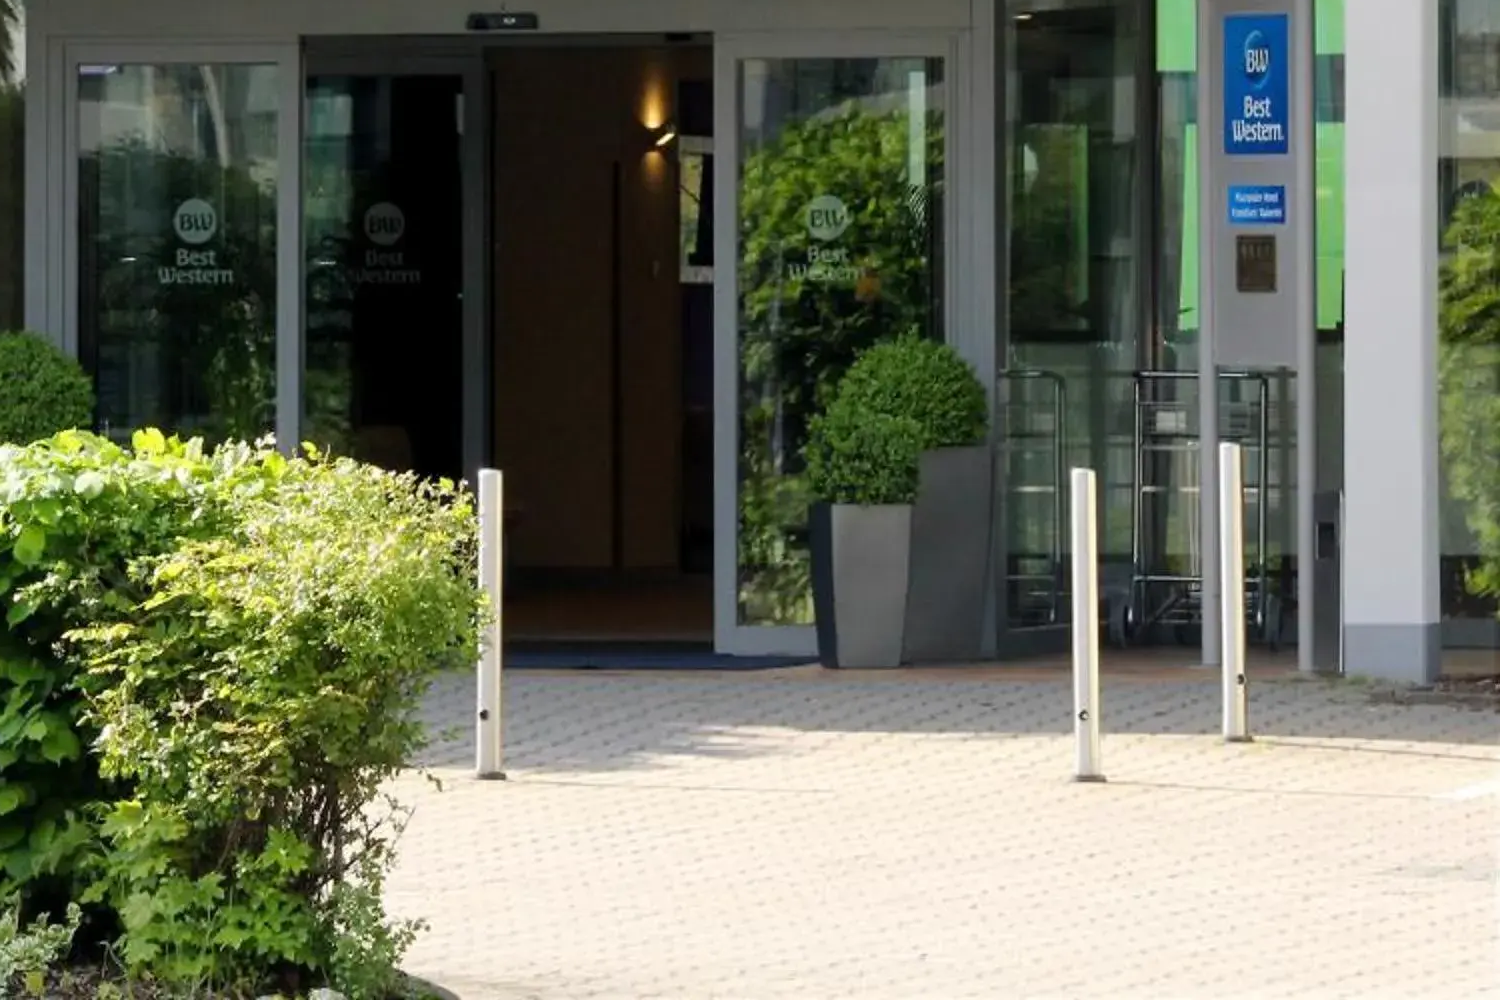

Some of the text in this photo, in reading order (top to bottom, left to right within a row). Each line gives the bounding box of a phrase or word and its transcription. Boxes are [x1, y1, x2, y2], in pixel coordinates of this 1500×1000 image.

[1246, 49, 1269, 73] BW
[1243, 95, 1272, 118] Best
[180, 213, 214, 232] BW
[176, 247, 216, 267] Best
[158, 266, 234, 285] Western
